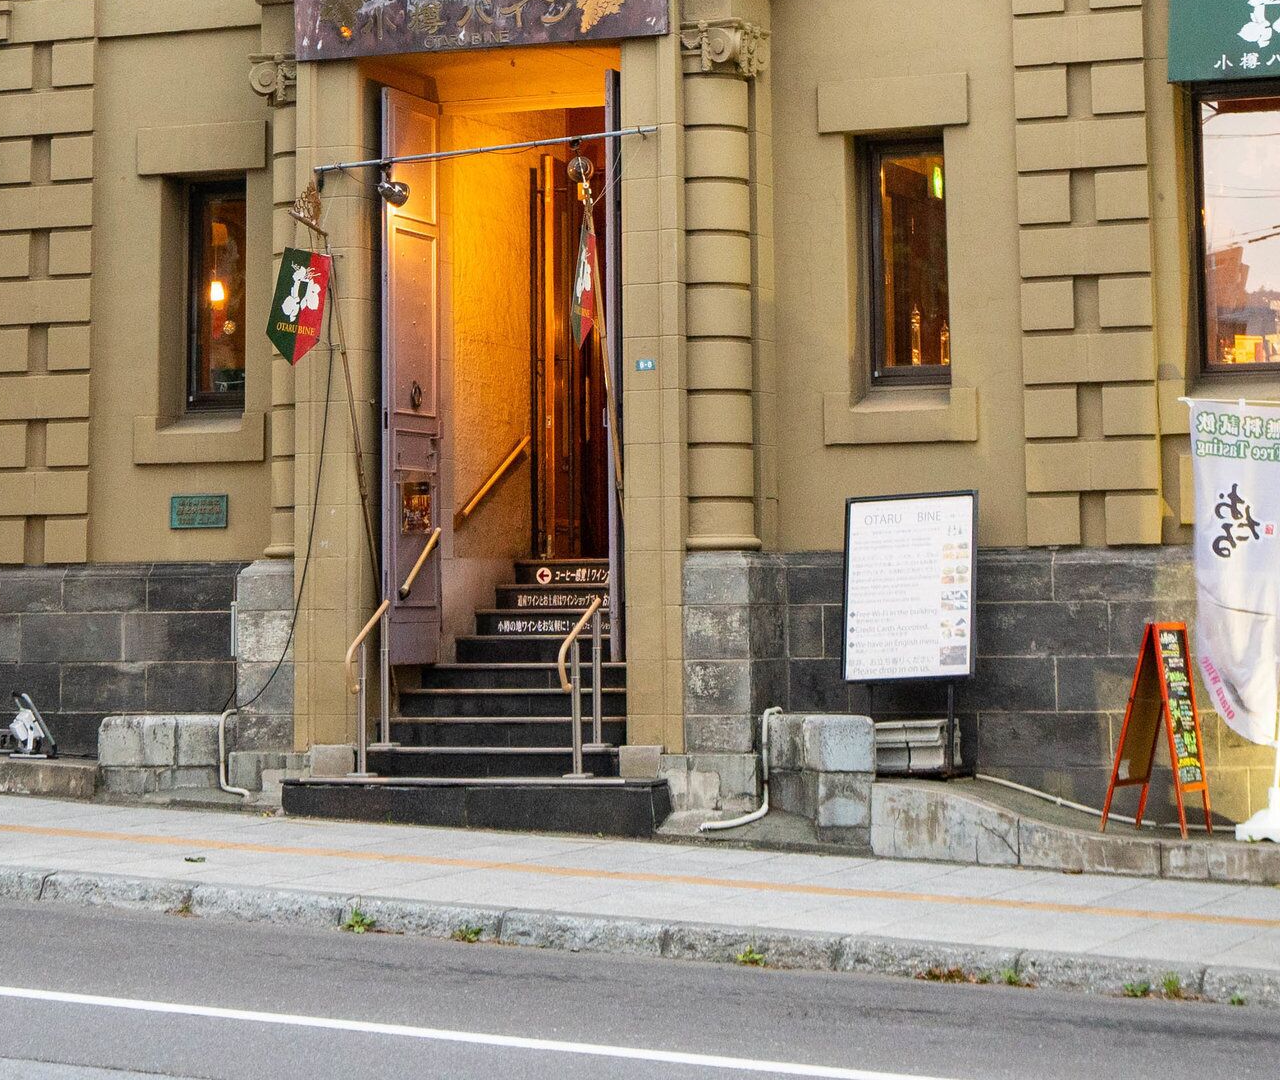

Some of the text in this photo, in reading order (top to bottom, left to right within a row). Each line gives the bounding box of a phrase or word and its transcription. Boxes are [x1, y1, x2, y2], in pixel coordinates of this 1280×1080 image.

[472, 30, 510, 45] BINE
[276, 322, 316, 336] OTARU BINE
[864, 513, 903, 526] OTARU
[917, 510, 942, 523] BINE
[554, 568, 609, 582] コーヒー感覚!ワイン
